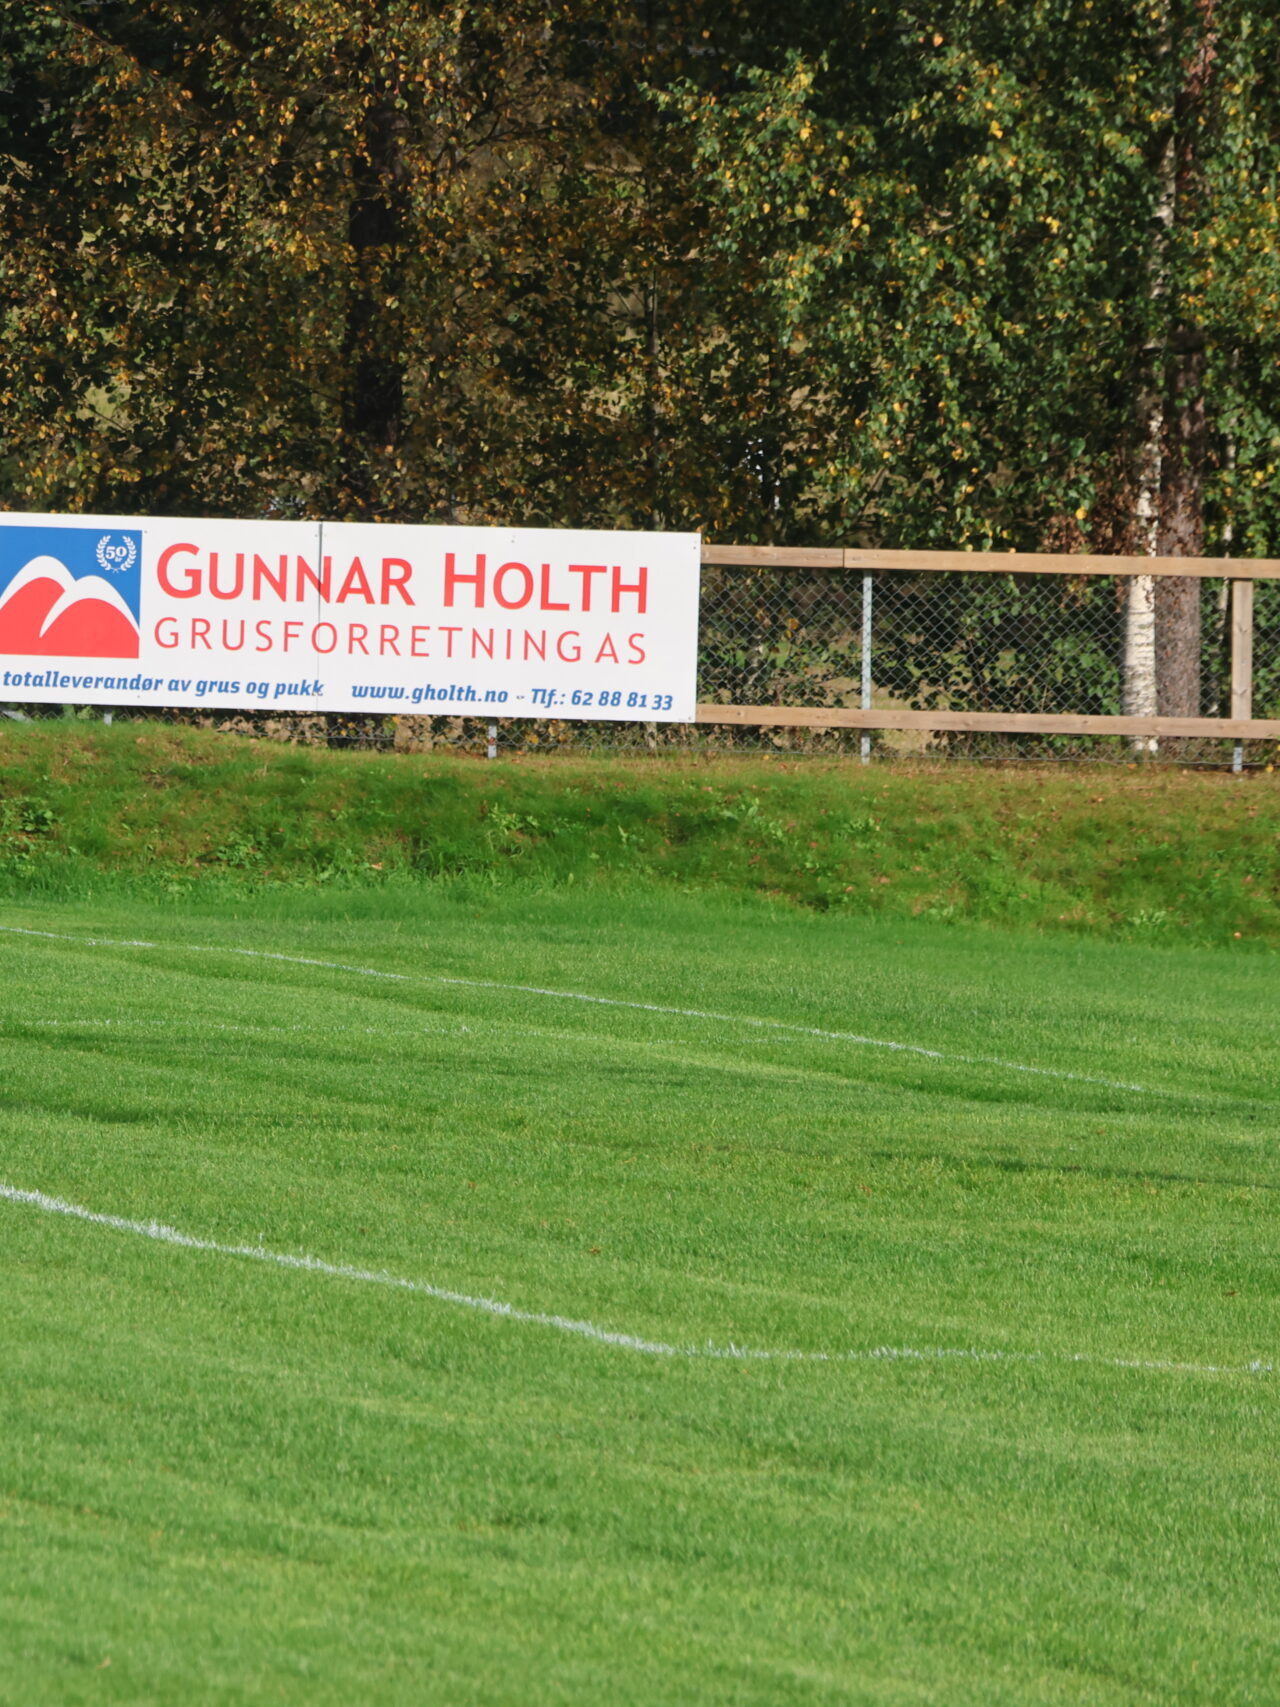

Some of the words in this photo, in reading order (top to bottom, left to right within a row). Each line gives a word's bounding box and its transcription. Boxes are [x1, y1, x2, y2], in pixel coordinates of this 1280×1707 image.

[105, 546, 127, 559] 50
[3, 670, 163, 692] totalleverandør
[168, 679, 191, 692] av
[195, 679, 240, 697] grus
[246, 682, 270, 699] og
[273, 679, 324, 700] pukk
[351, 684, 508, 704] www.gholth.no
[571, 690, 593, 706] 62
[598, 691, 621, 707] 88
[627, 692, 648, 708] 81
[652, 695, 673, 710] 33
